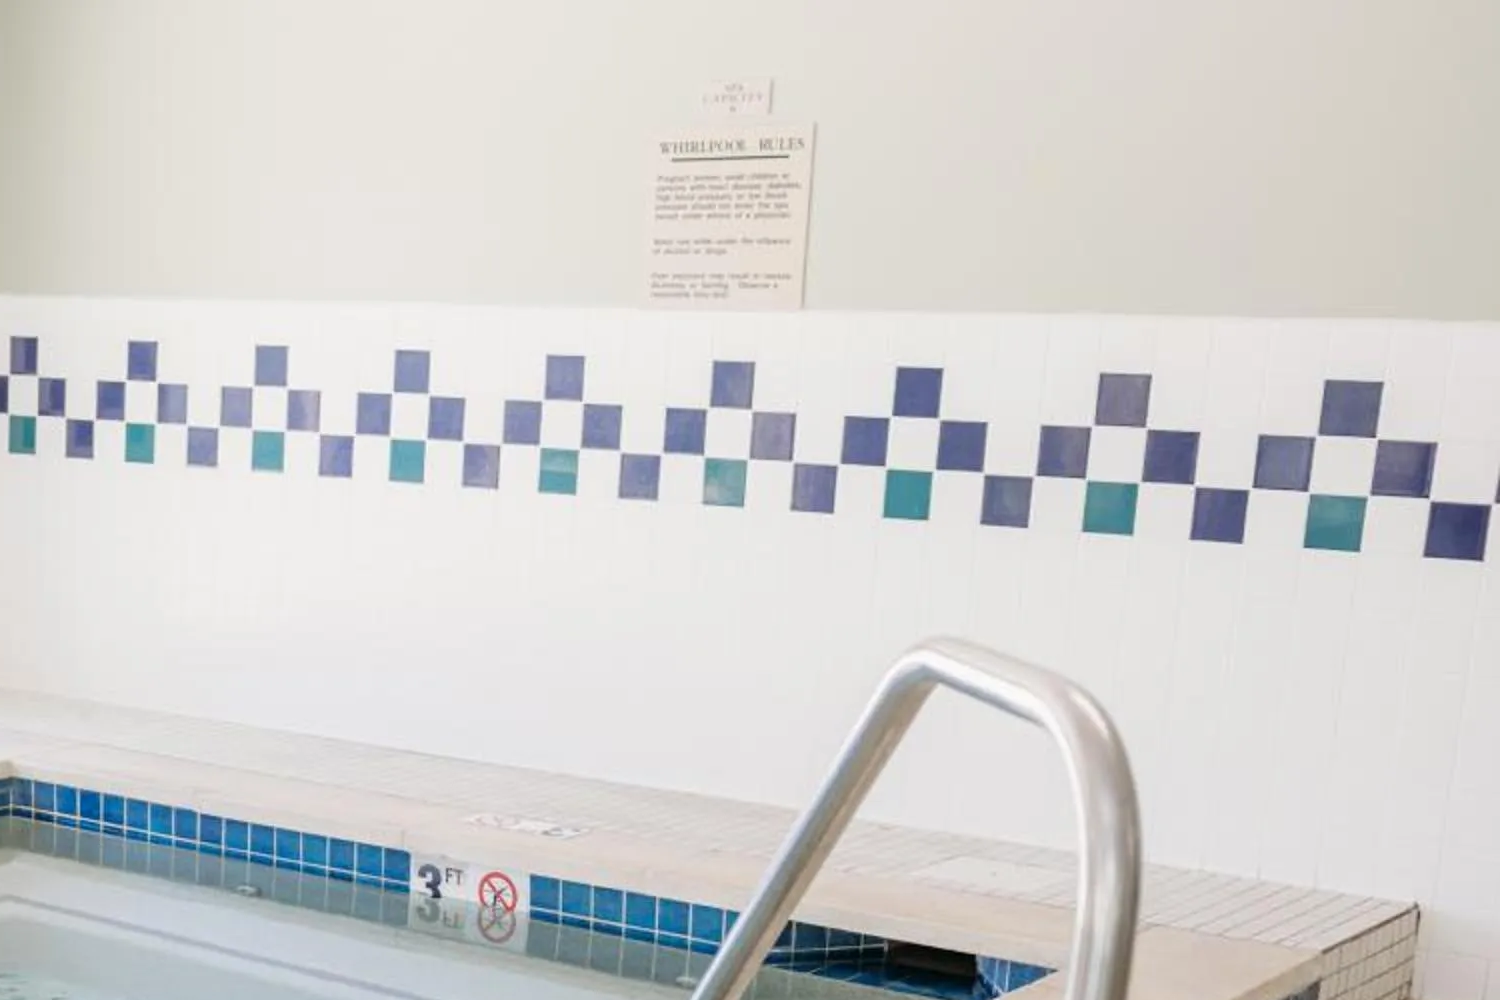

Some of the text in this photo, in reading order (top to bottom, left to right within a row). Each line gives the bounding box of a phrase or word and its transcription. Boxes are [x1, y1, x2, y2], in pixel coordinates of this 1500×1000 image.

[659, 137, 805, 155] WHIRLPOOL RULES
[417, 863, 464, 898] 3 FT
